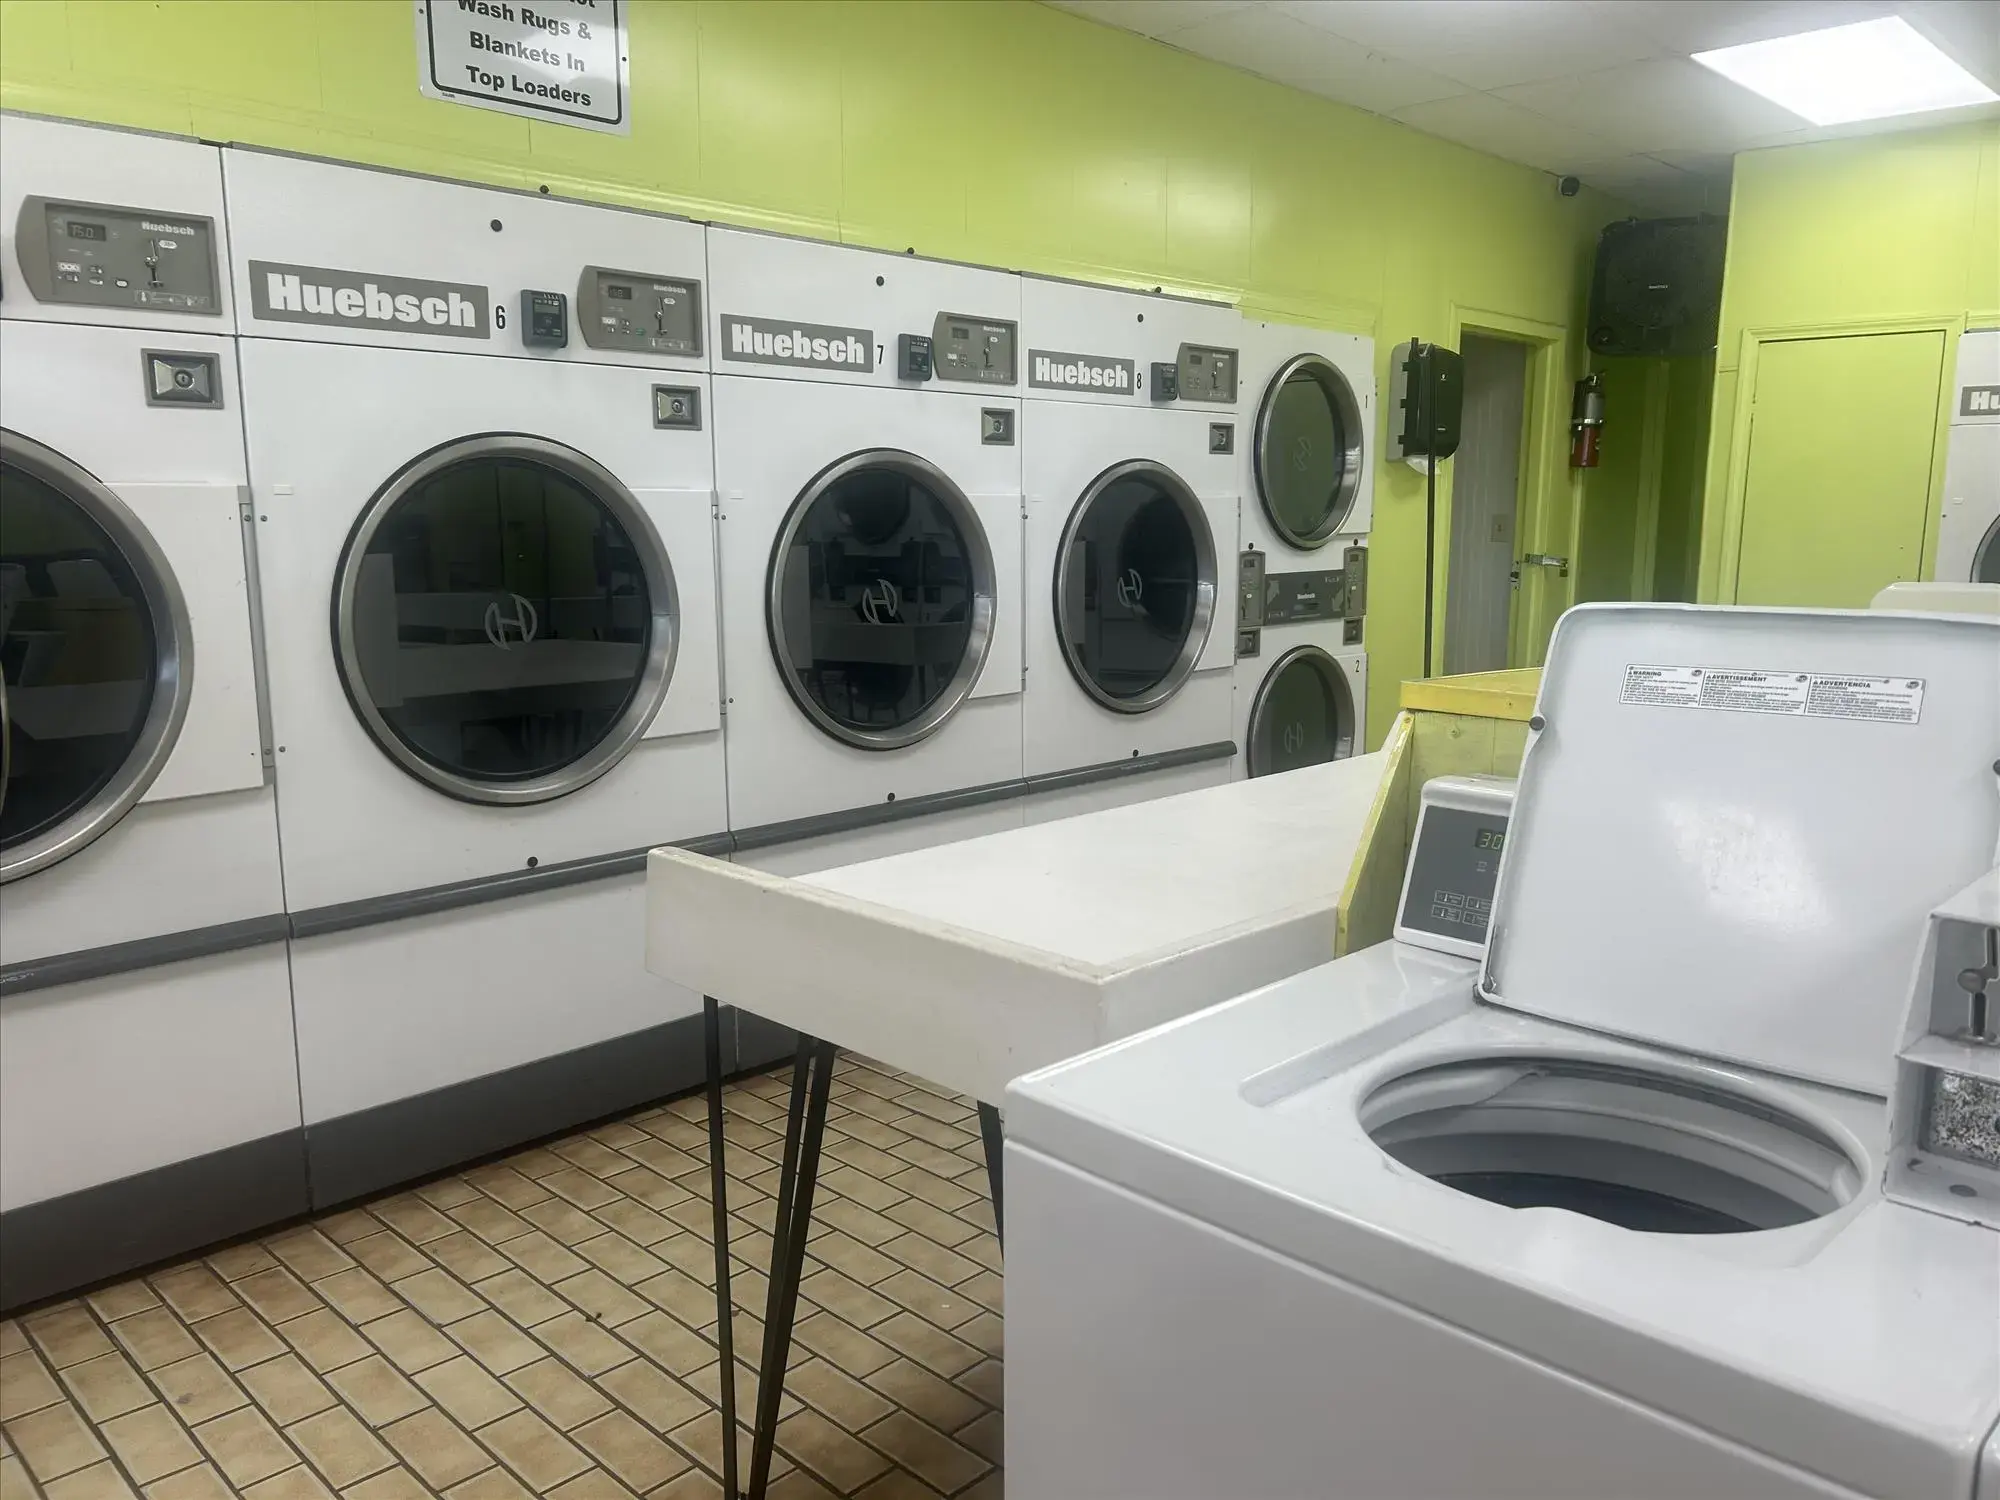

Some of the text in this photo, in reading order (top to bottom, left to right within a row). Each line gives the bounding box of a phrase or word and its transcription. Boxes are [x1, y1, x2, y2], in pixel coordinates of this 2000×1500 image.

[458, 0, 592, 40] Wash Rugs &
[469, 31, 585, 72] Blankets In
[466, 64, 592, 106] Top Loaders
[141, 221, 195, 235] Huebsch
[267, 272, 476, 328] Huebsch
[495, 305, 506, 329] 6
[731, 323, 865, 364] Huebsch
[877, 345, 884, 365] 7
[1035, 357, 1128, 388] Huebsch
[1136, 372, 1142, 389] 8
[1355, 660, 1360, 672] 2
[1712, 674, 1767, 682] AVERTISSEMENT
[1819, 680, 1871, 688] ADVERTENCIA
[1480, 832, 1503, 849] 30
